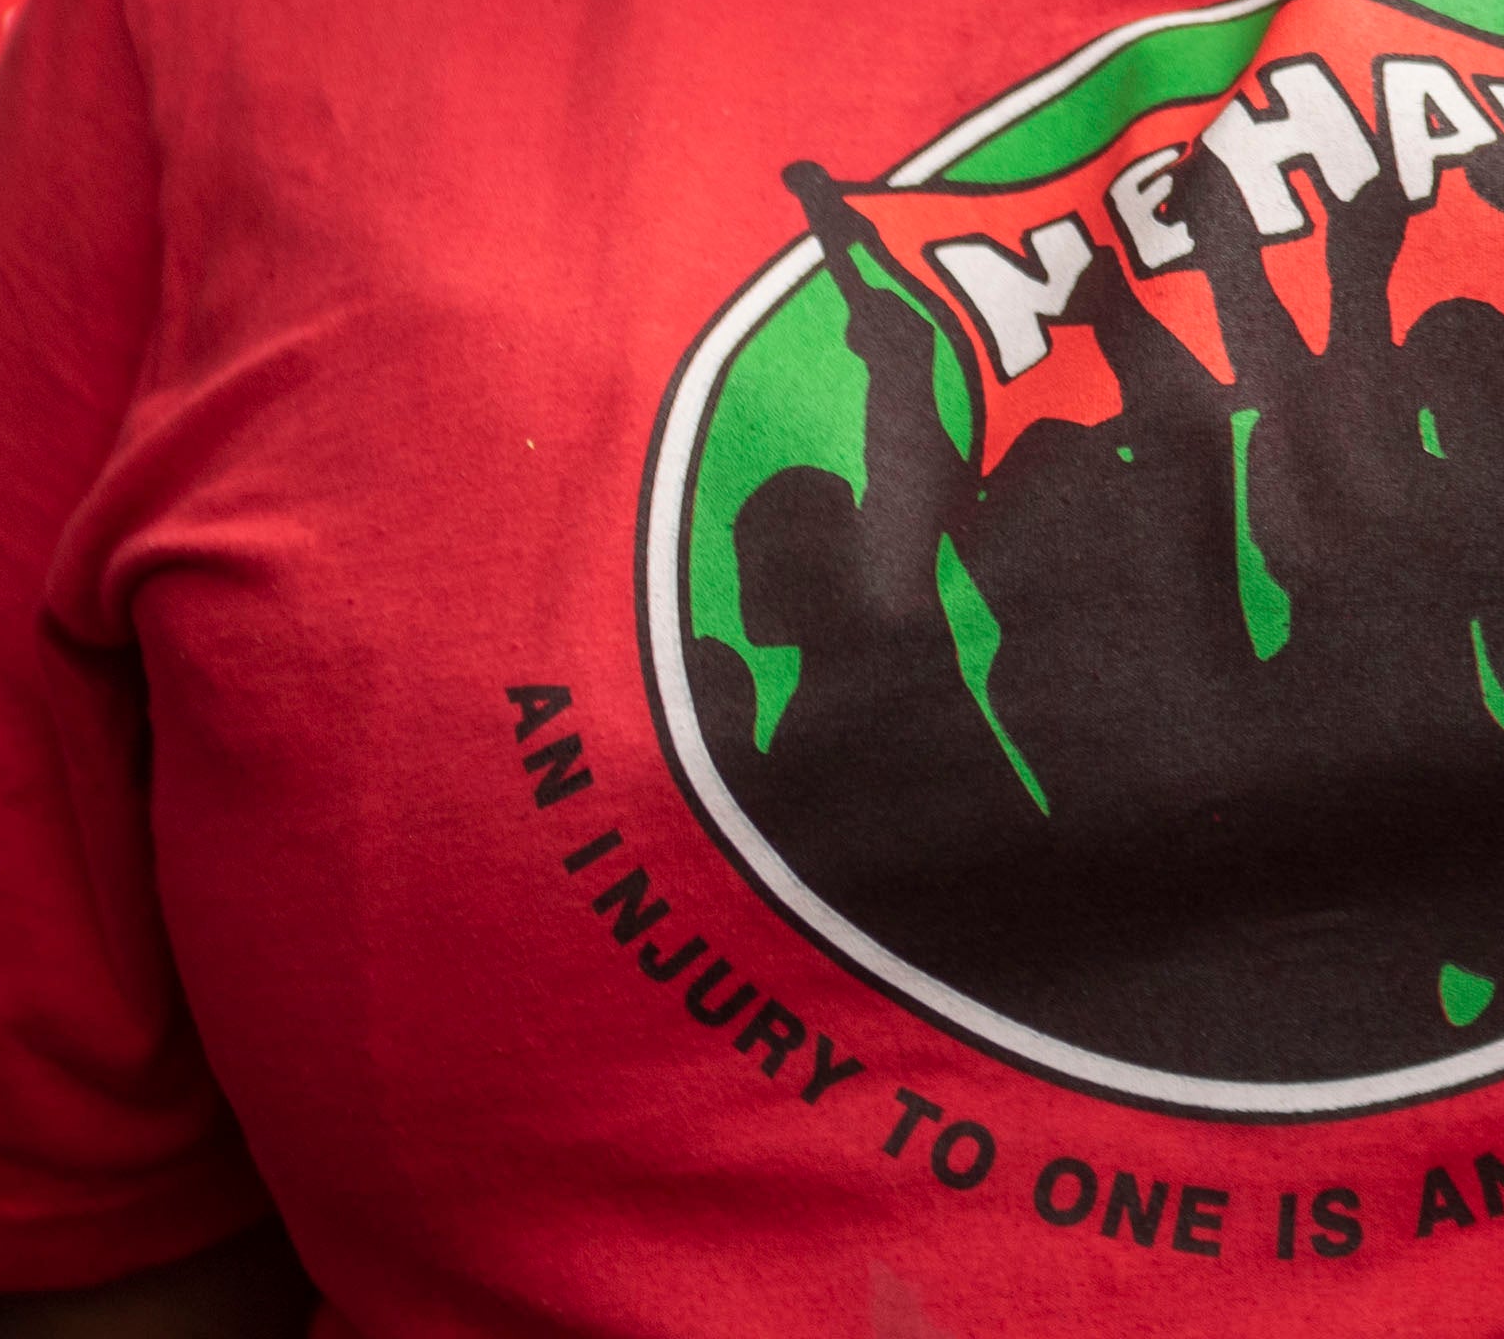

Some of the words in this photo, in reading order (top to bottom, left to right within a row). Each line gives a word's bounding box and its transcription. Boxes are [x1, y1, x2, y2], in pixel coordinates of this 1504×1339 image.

[505, 684, 594, 810] AN
[562, 828, 866, 1105] INJURY
[882, 1087, 996, 1190] TO
[1033, 1157, 1229, 1258] ONE
[1276, 1187, 1364, 1261] IS
